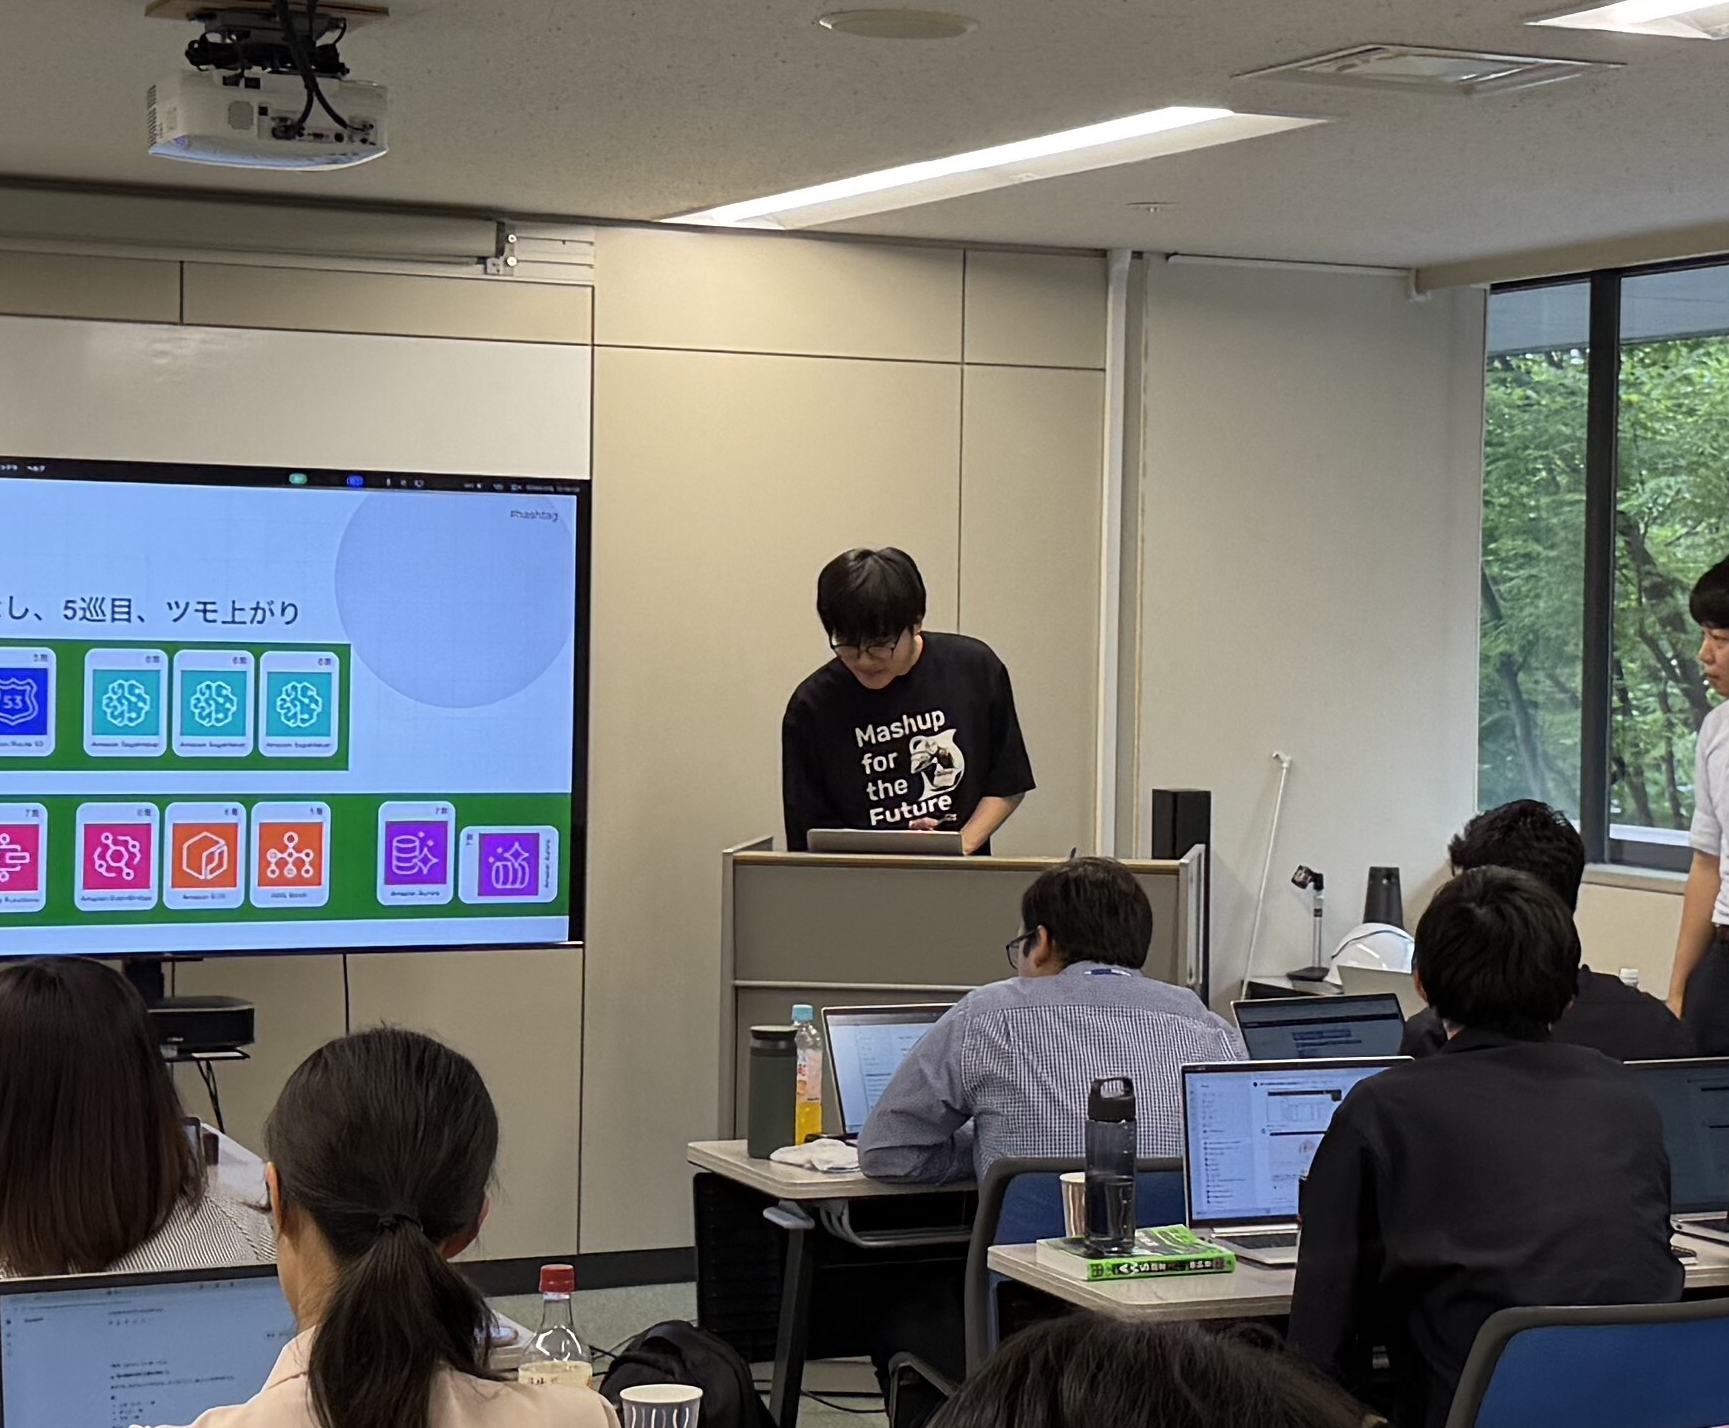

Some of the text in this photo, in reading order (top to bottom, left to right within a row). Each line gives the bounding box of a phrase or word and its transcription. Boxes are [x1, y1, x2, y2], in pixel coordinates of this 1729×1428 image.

[854, 709, 946, 748] Mashup
[861, 750, 898, 775] for
[866, 778, 909, 802] the
[869, 793, 953, 826] Future
